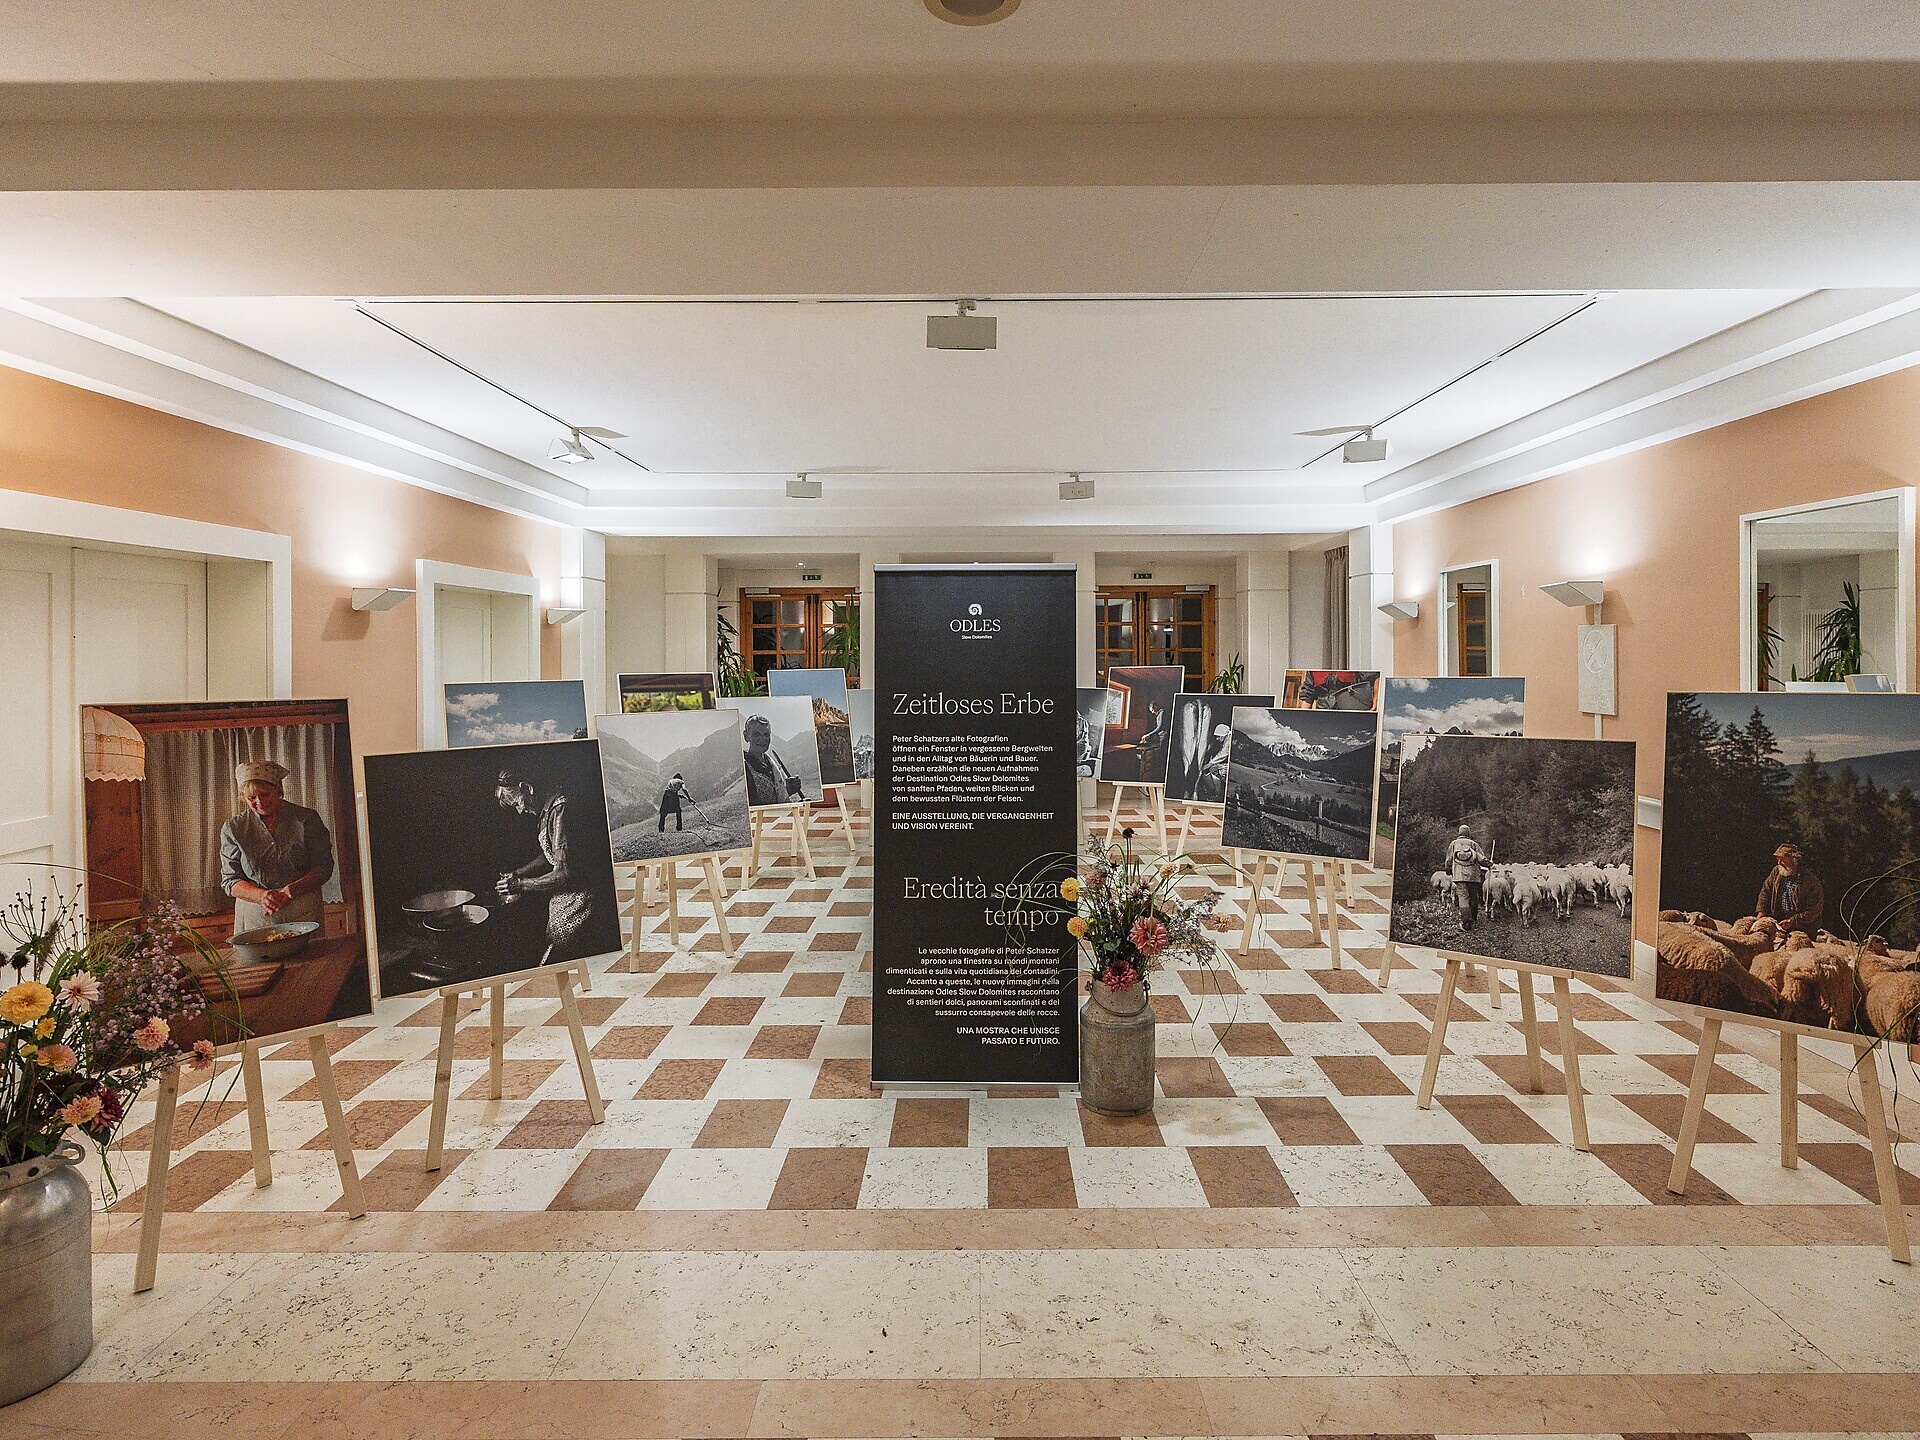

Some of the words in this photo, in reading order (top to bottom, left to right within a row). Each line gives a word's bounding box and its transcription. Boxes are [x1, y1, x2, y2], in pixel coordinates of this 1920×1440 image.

[950, 619, 1001, 632] ODLES
[893, 692, 993, 714] Zeitloses
[1000, 692, 1054, 714] Erbe
[967, 735, 1008, 743] Fotografien
[1012, 745, 1053, 753] Bergwelten
[932, 755, 953, 763] Alltag
[904, 876, 987, 899] Eredità
[994, 882, 1059, 899] senza
[984, 907, 1059, 932] tempo
[959, 947, 995, 955] fotografie
[1004, 957, 1027, 965] mondi
[1029, 957, 1059, 965] montani
[1023, 967, 1060, 975] contadini.
[1007, 977, 1040, 986] immagini
[1042, 977, 1059, 985] della
[967, 999, 1001, 1007] panorami
[1003, 998, 1040, 1006] sconfinati
[969, 1009, 1015, 1017] consapevole
